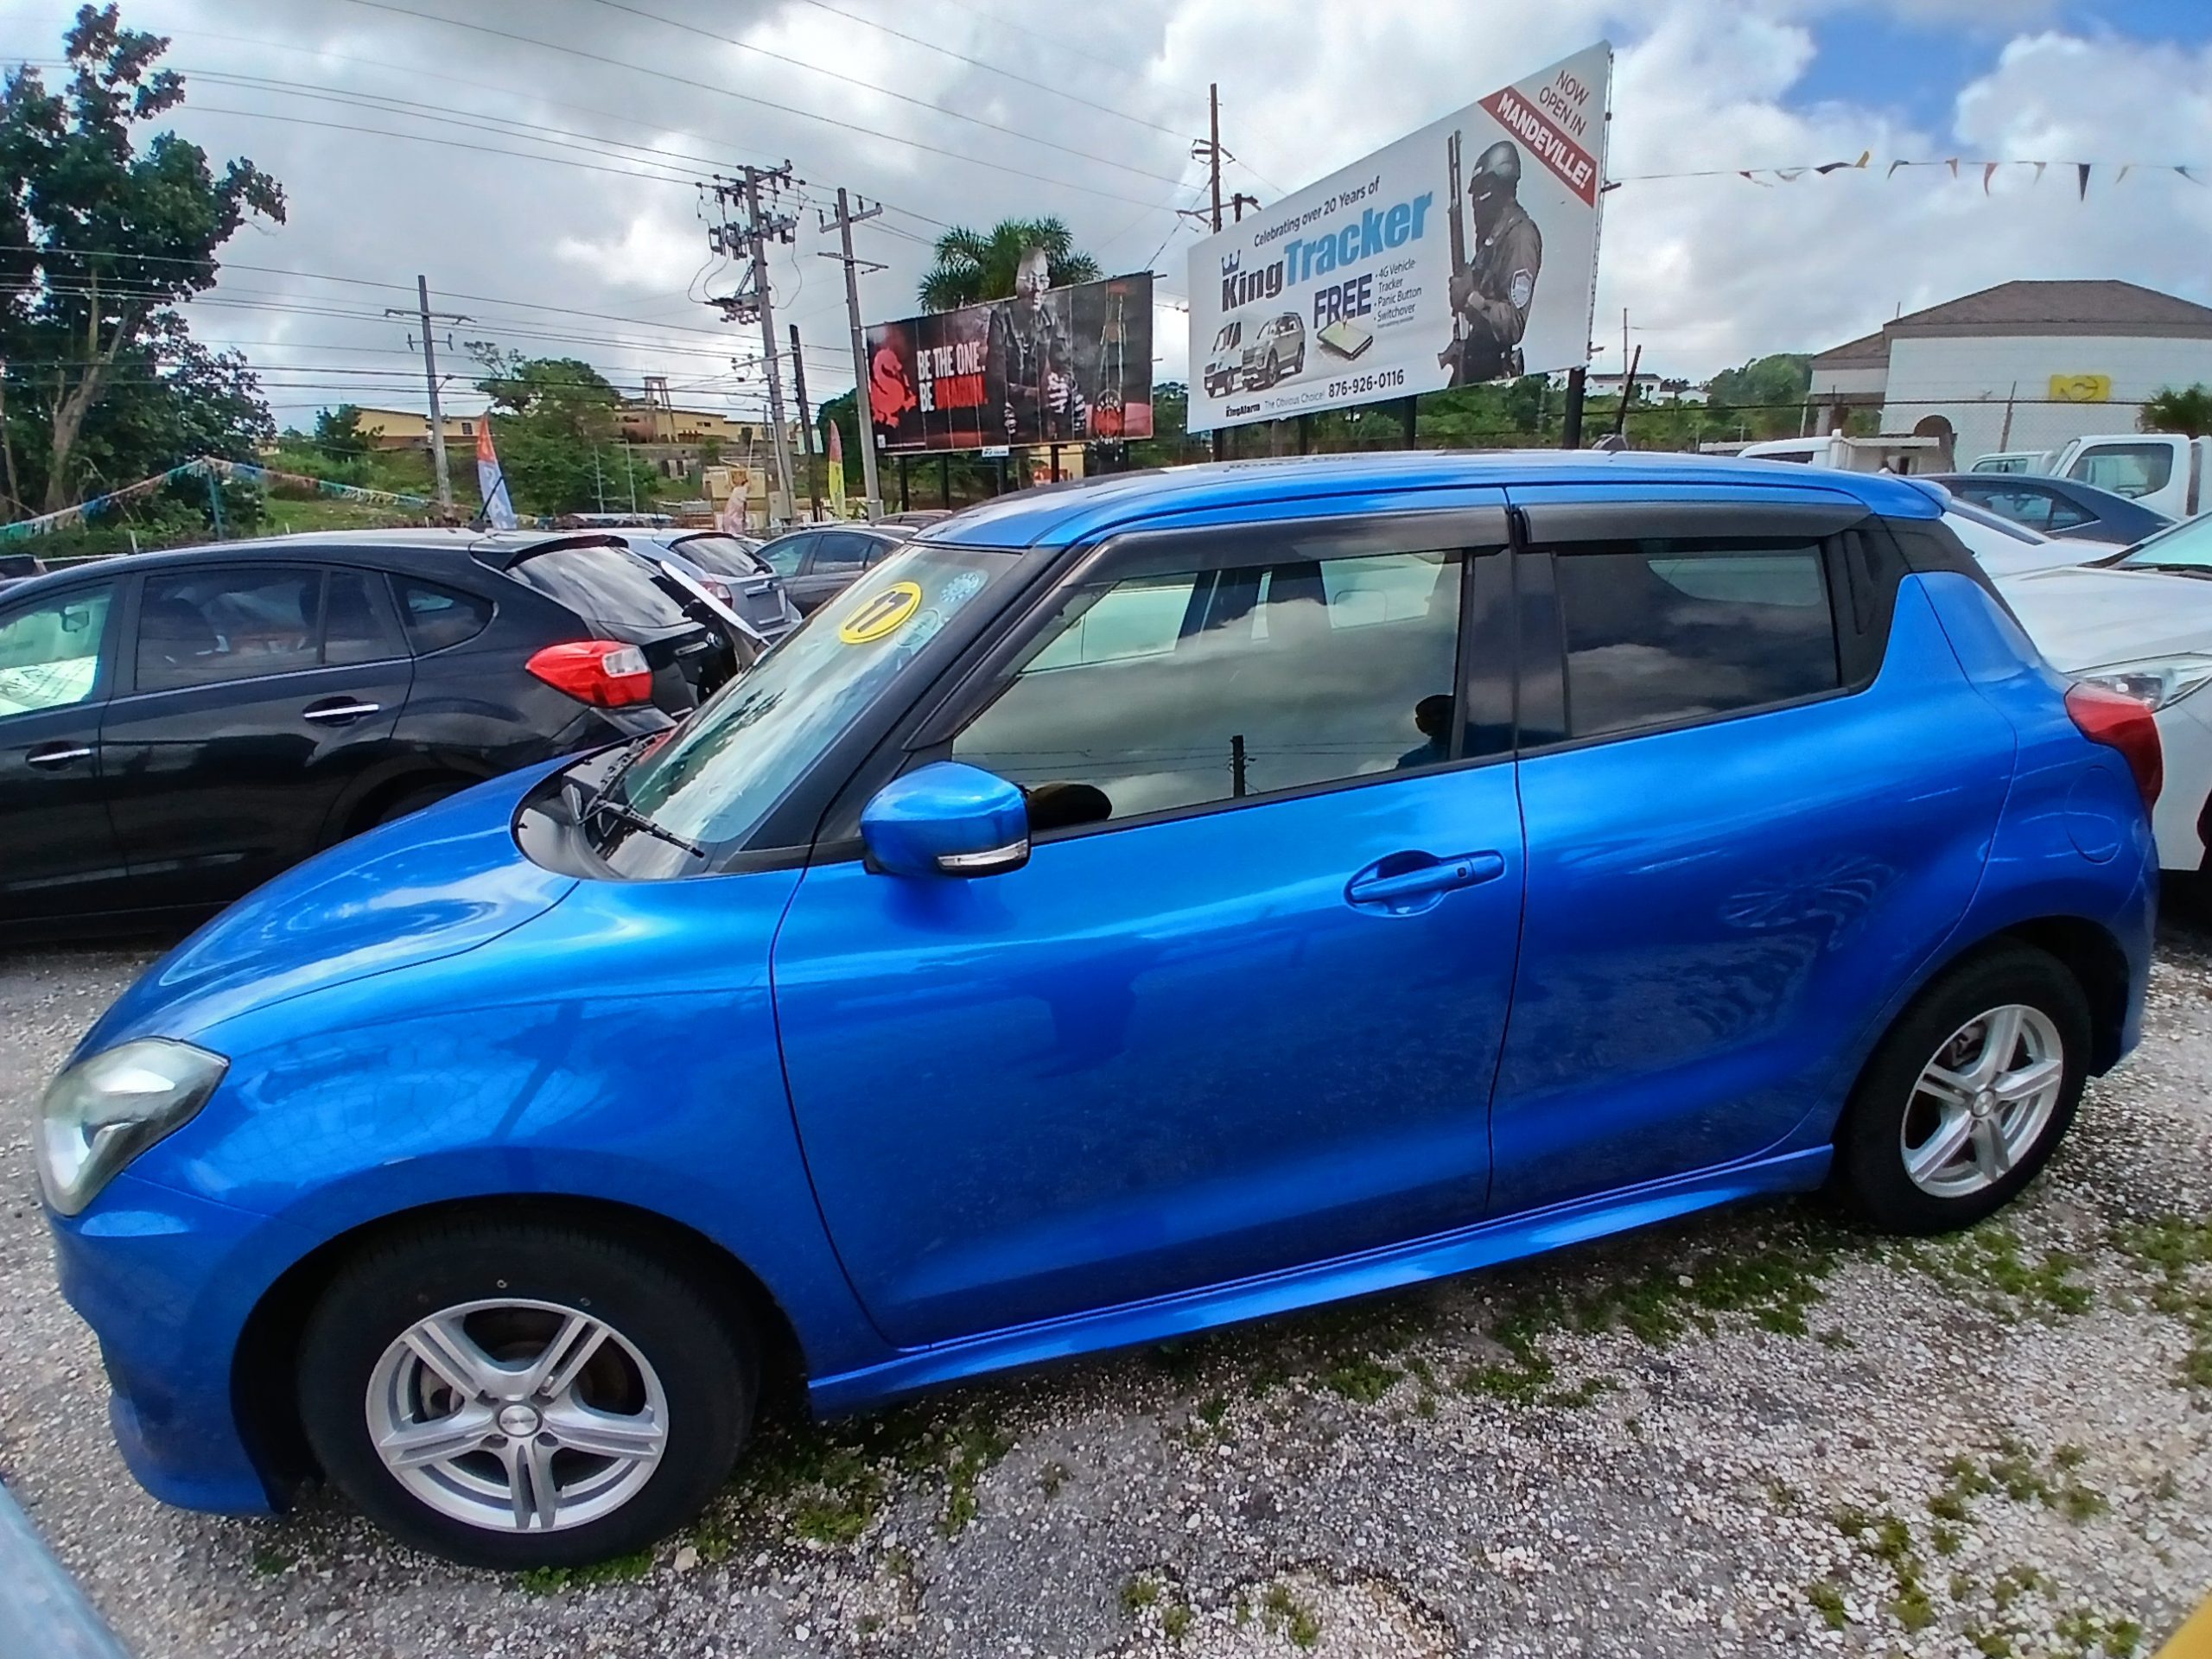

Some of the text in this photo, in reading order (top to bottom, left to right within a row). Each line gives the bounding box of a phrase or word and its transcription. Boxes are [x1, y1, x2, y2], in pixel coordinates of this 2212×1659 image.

[1555, 70, 1590, 106] NOW
[1539, 86, 1586, 137] OPEN IN
[1497, 92, 1592, 189] MANDEVILLE!
[1255, 175, 1380, 246] Celebrating over 20 Years of
[1390, 258, 1416, 276] Vehicle
[1313, 273, 1372, 329] FREE
[1377, 287, 1422, 308] Panic Button
[1379, 277, 1403, 294] Tracker
[1377, 302, 1416, 322] Switchover
[917, 350, 932, 381] BE
[933, 346, 955, 378] THE
[918, 381, 935, 413] BE
[1328, 369, 1404, 398] 876-926-0116
[845, 590, 912, 632] 17
